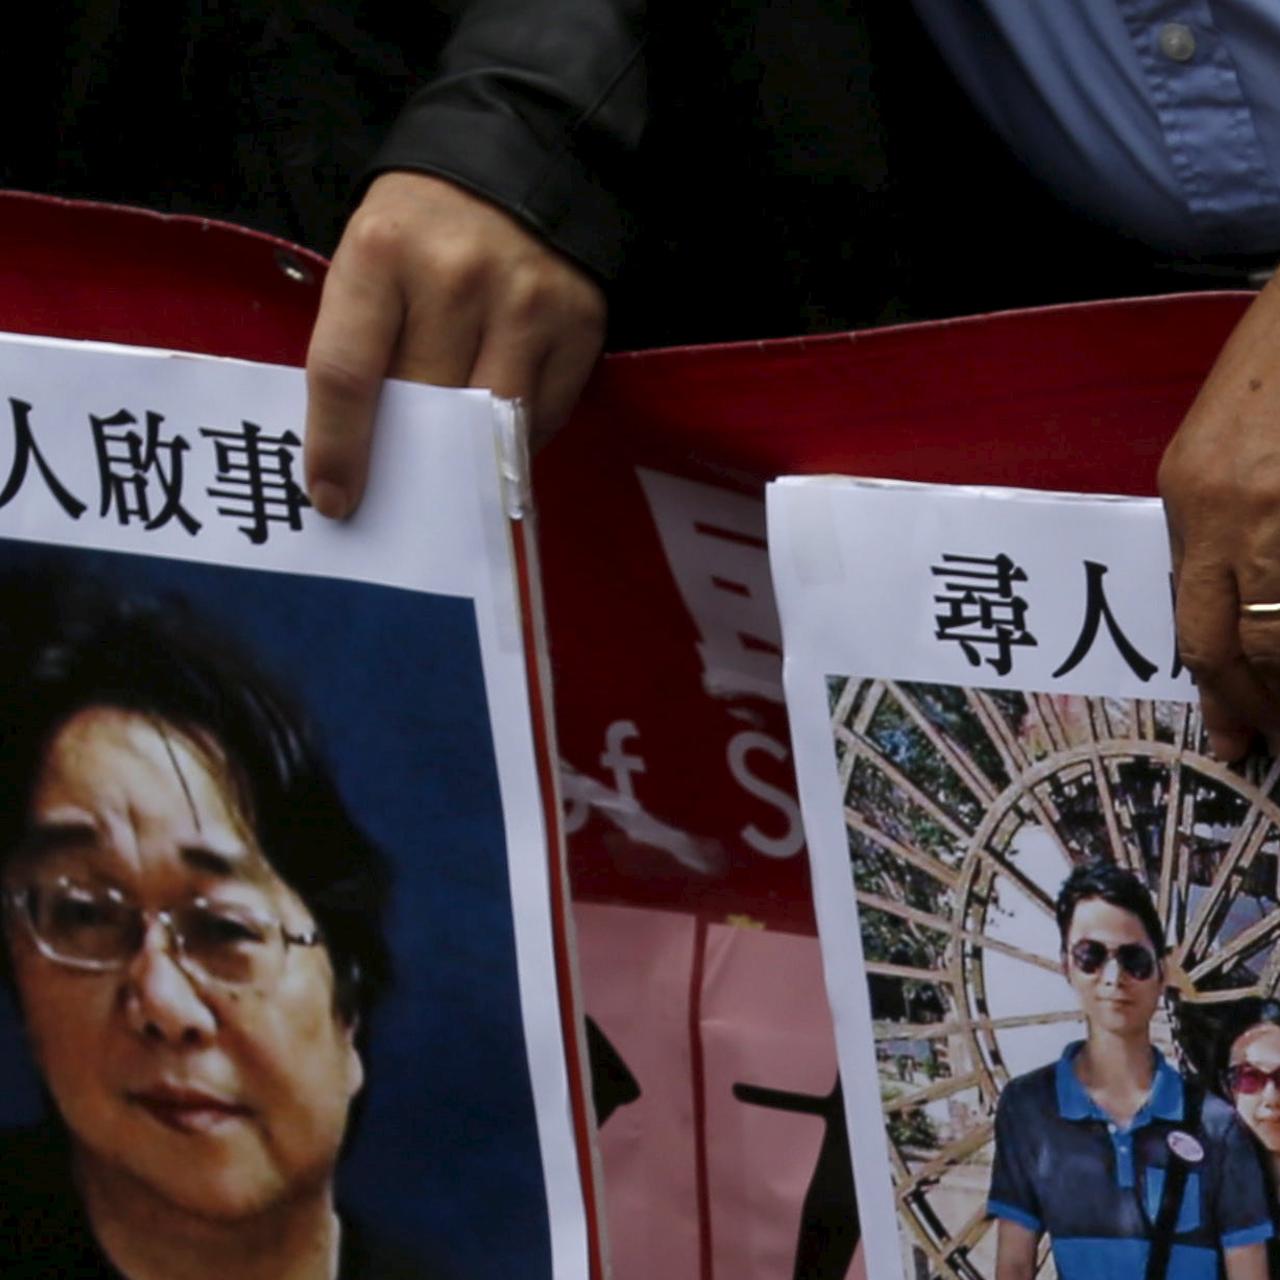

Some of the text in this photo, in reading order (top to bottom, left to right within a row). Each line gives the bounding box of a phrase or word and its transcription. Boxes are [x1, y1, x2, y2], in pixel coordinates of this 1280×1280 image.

[0, 397, 311, 546] 人啟事
[931, 552, 1192, 684] 尋人
